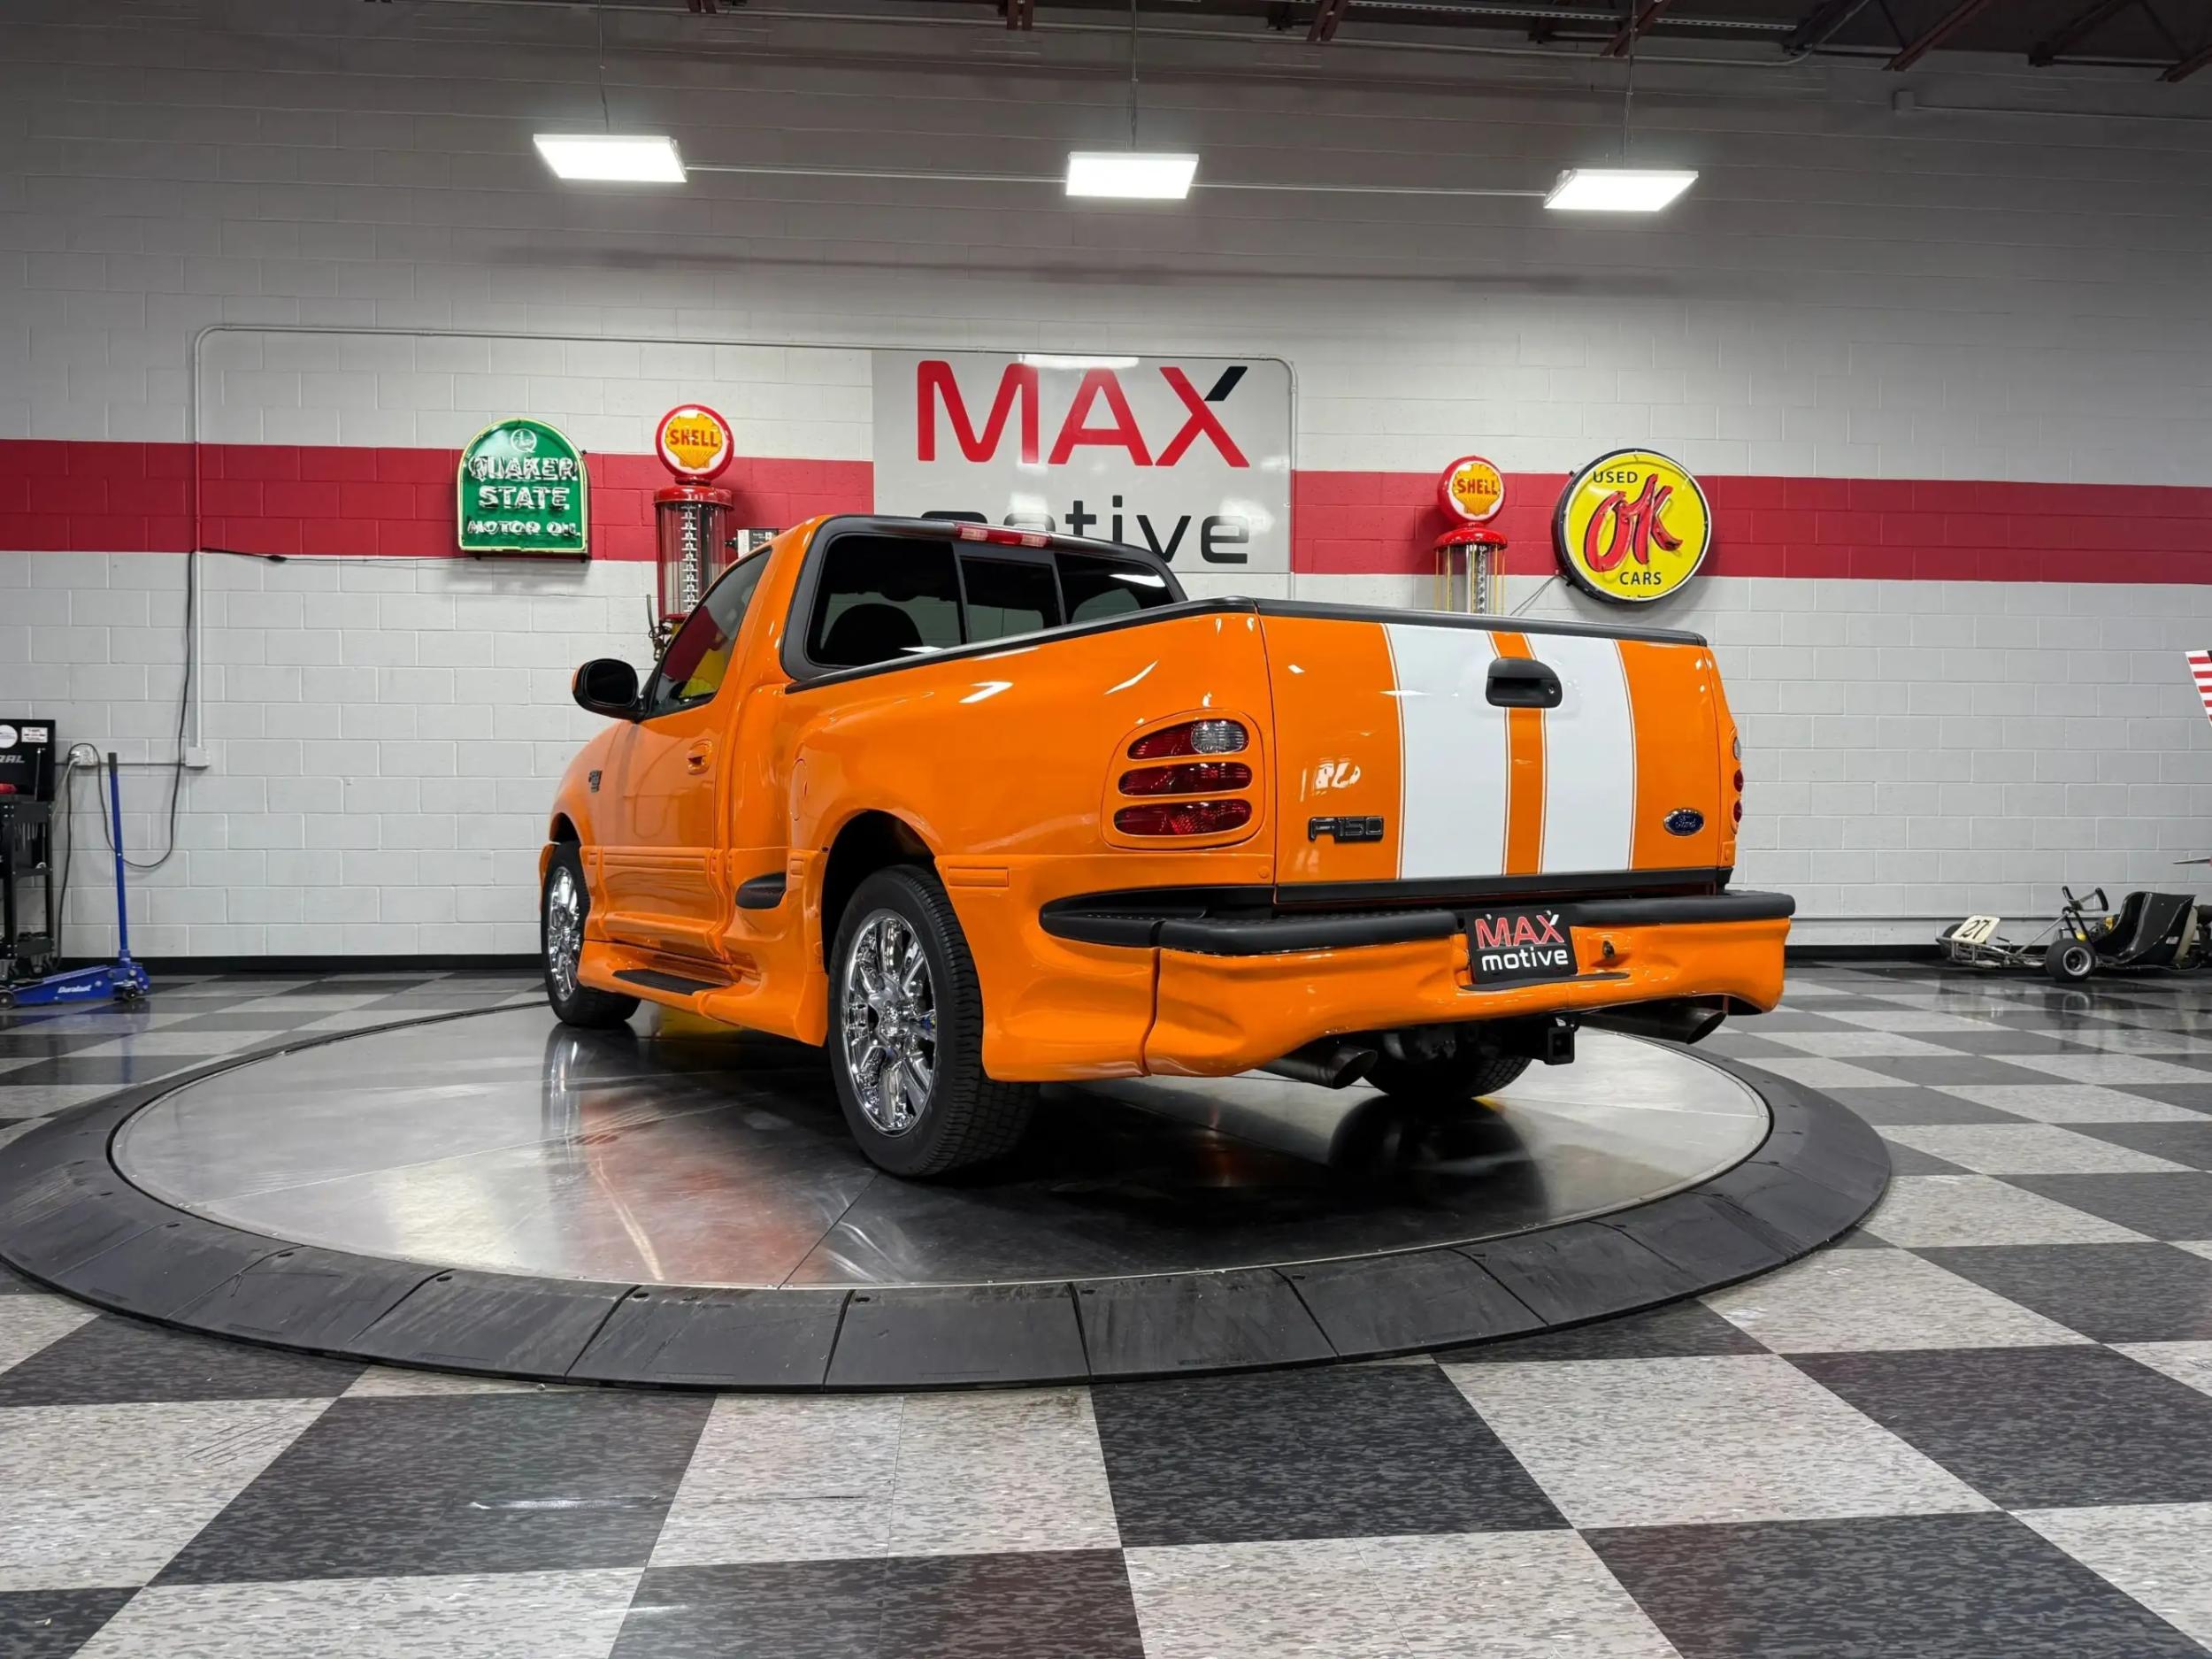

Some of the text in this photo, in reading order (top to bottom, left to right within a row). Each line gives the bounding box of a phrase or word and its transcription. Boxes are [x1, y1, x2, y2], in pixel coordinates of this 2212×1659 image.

[918, 360, 1250, 467] MAX
[670, 429, 718, 447] SHELL
[468, 456, 578, 481] QUAKER
[1593, 472, 1638, 483] USED
[479, 485, 570, 510] STATE
[1457, 479, 1497, 495] SHELL
[467, 520, 541, 535] MOTOR
[921, 495, 1249, 565] tive
[1584, 473, 1684, 572] OK
[1620, 572, 1662, 585] CARS
[1475, 914, 1564, 949] MAX
[1960, 919, 1991, 940] 27
[1481, 946, 1569, 972] motive
